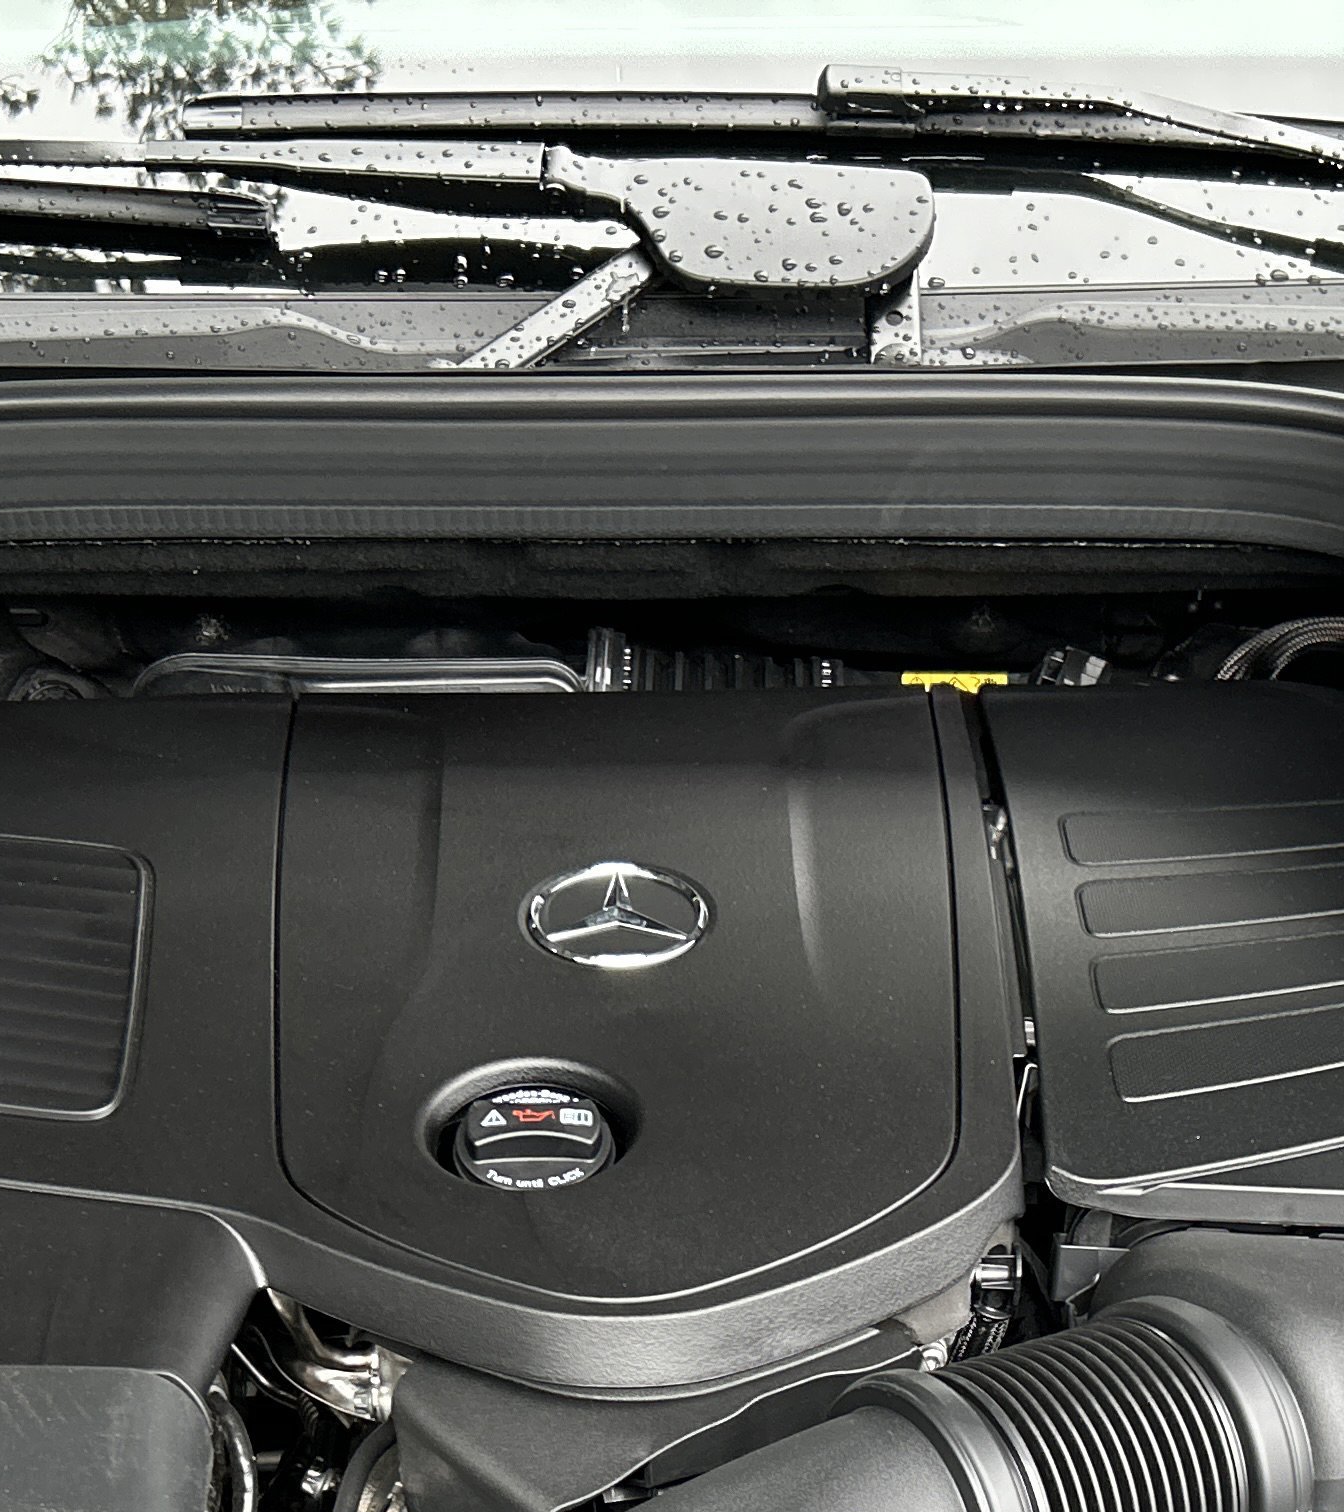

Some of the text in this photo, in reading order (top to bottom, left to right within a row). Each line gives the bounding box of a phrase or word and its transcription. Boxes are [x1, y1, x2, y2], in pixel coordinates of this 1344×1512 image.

[486, 1167, 585, 1188] Turn until CLICK
